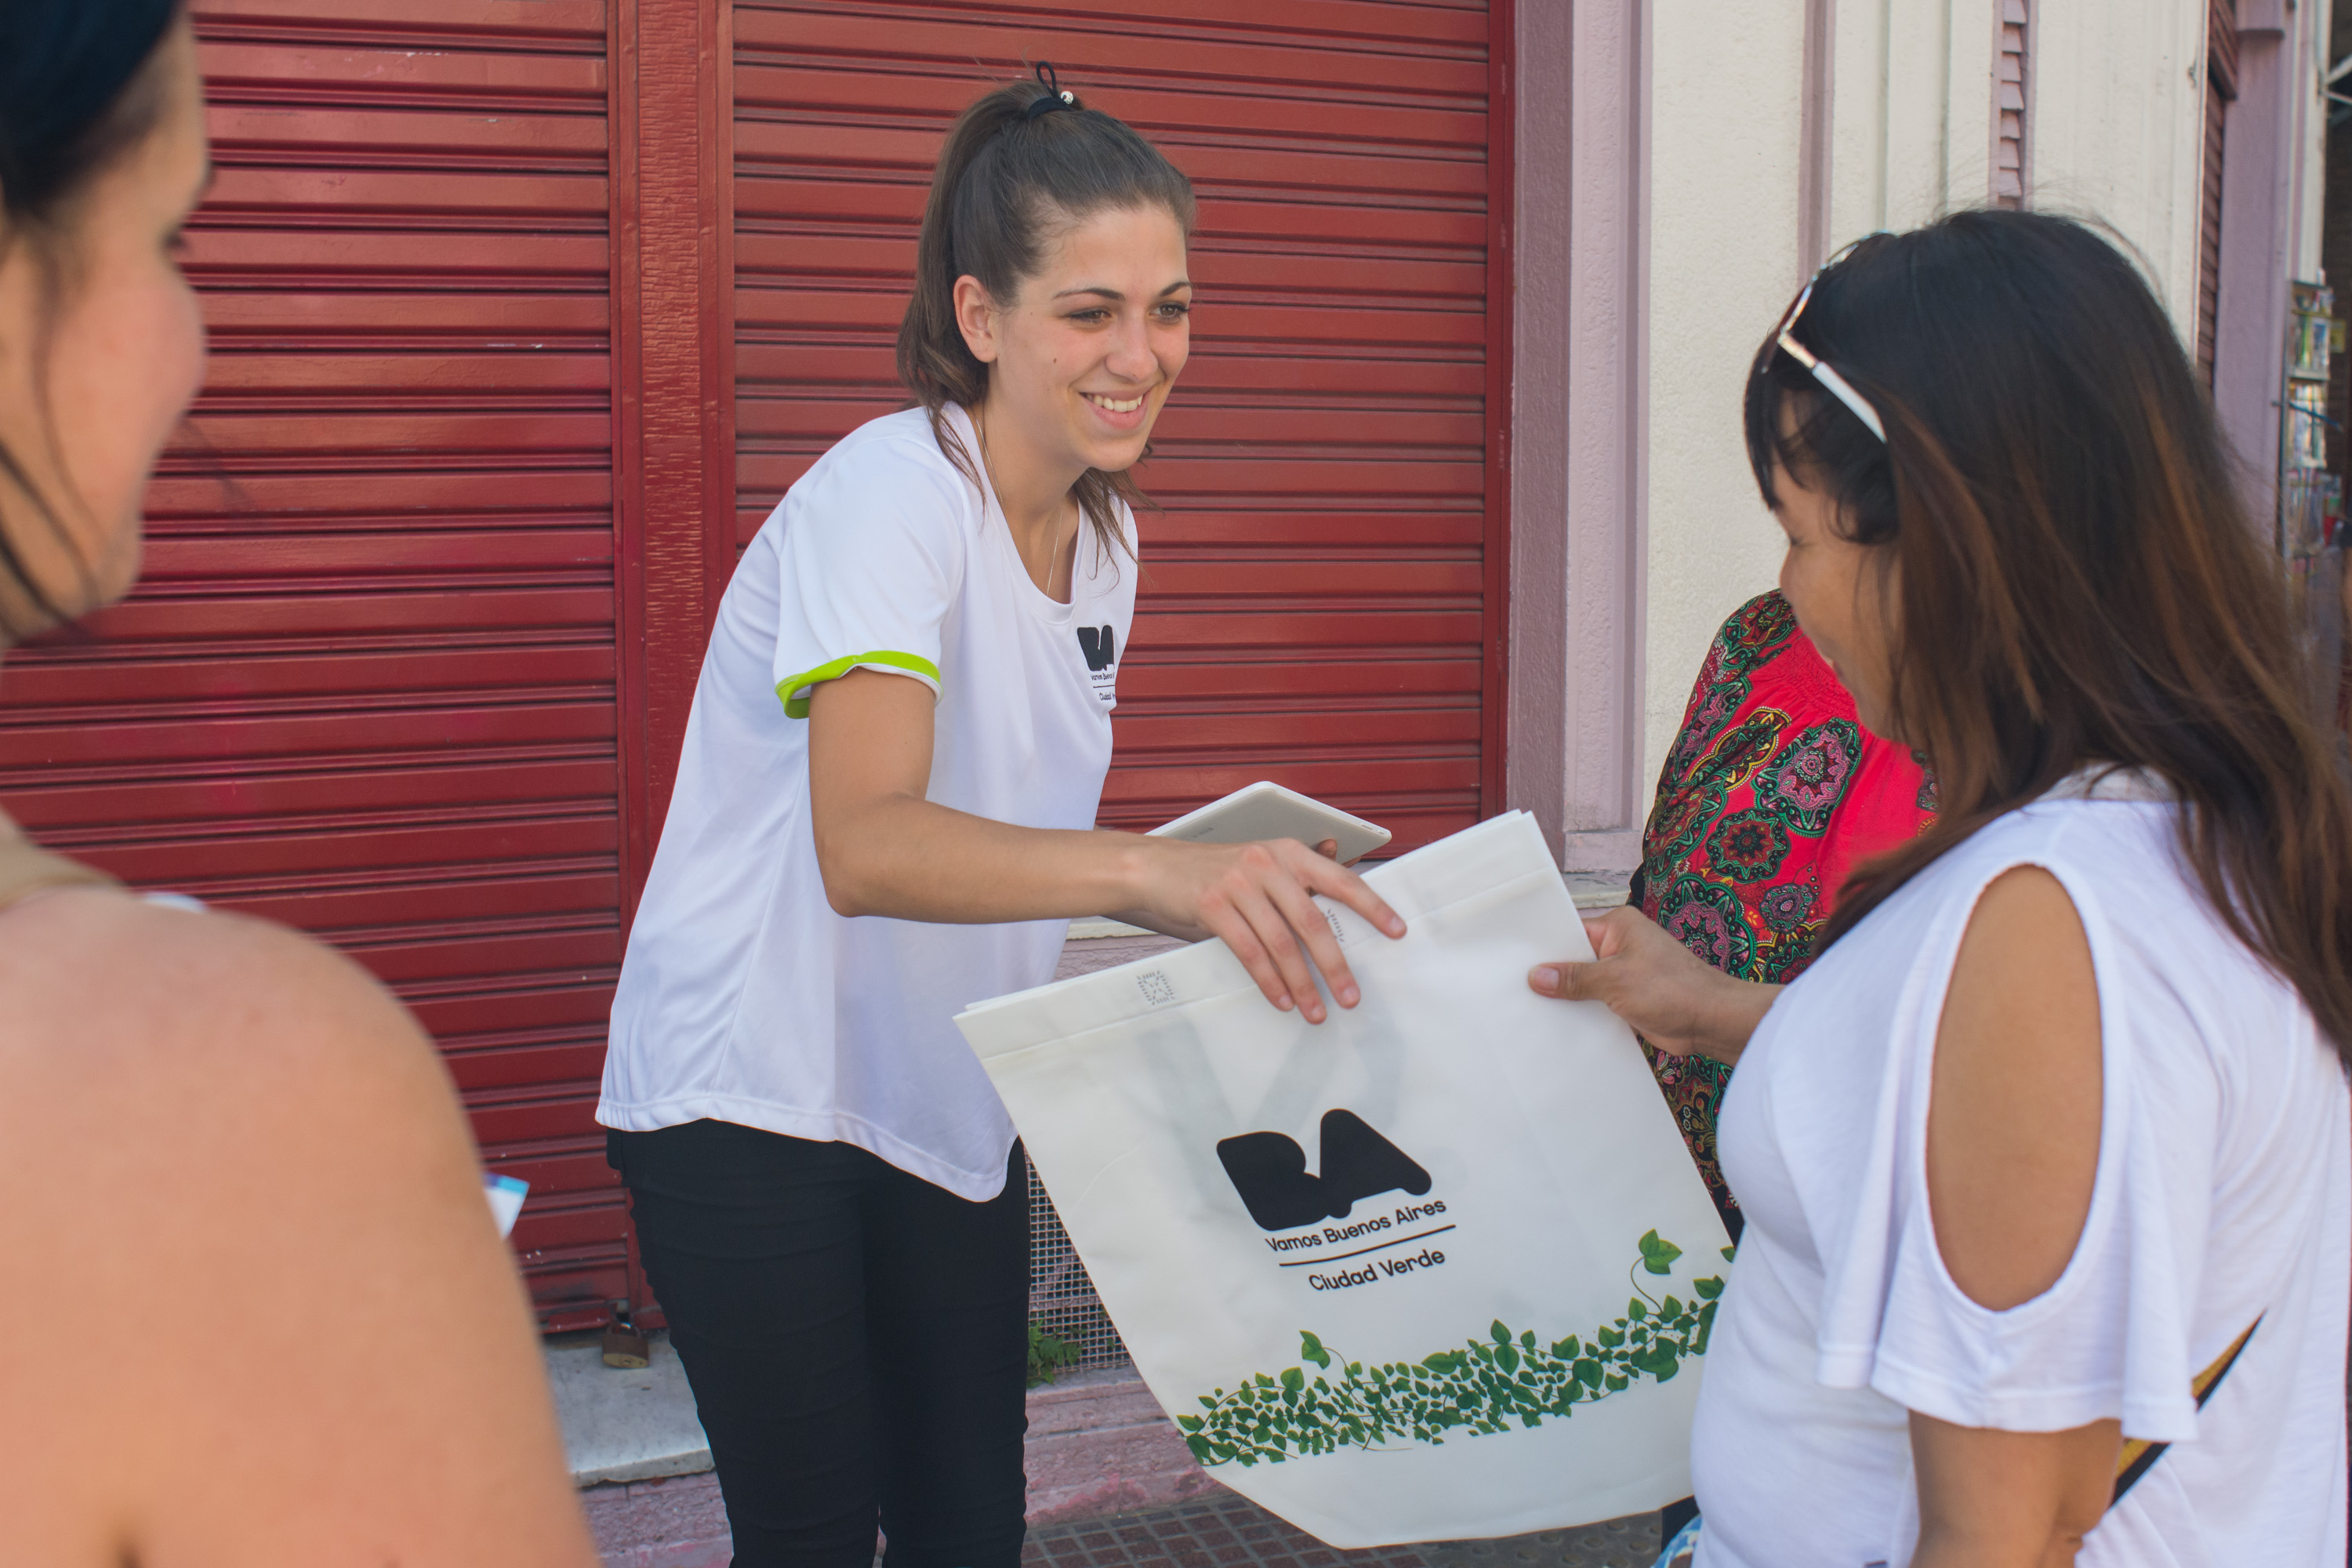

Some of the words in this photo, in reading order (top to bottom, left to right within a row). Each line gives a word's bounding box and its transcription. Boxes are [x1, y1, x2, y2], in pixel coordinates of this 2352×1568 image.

[1265, 1235, 1323, 1252] Vamos
[1323, 1216, 1392, 1243] Buenos
[1396, 1200, 1446, 1225] Aires
[1308, 1263, 1379, 1291] Ciudad
[1377, 1249, 1446, 1277] Verde
